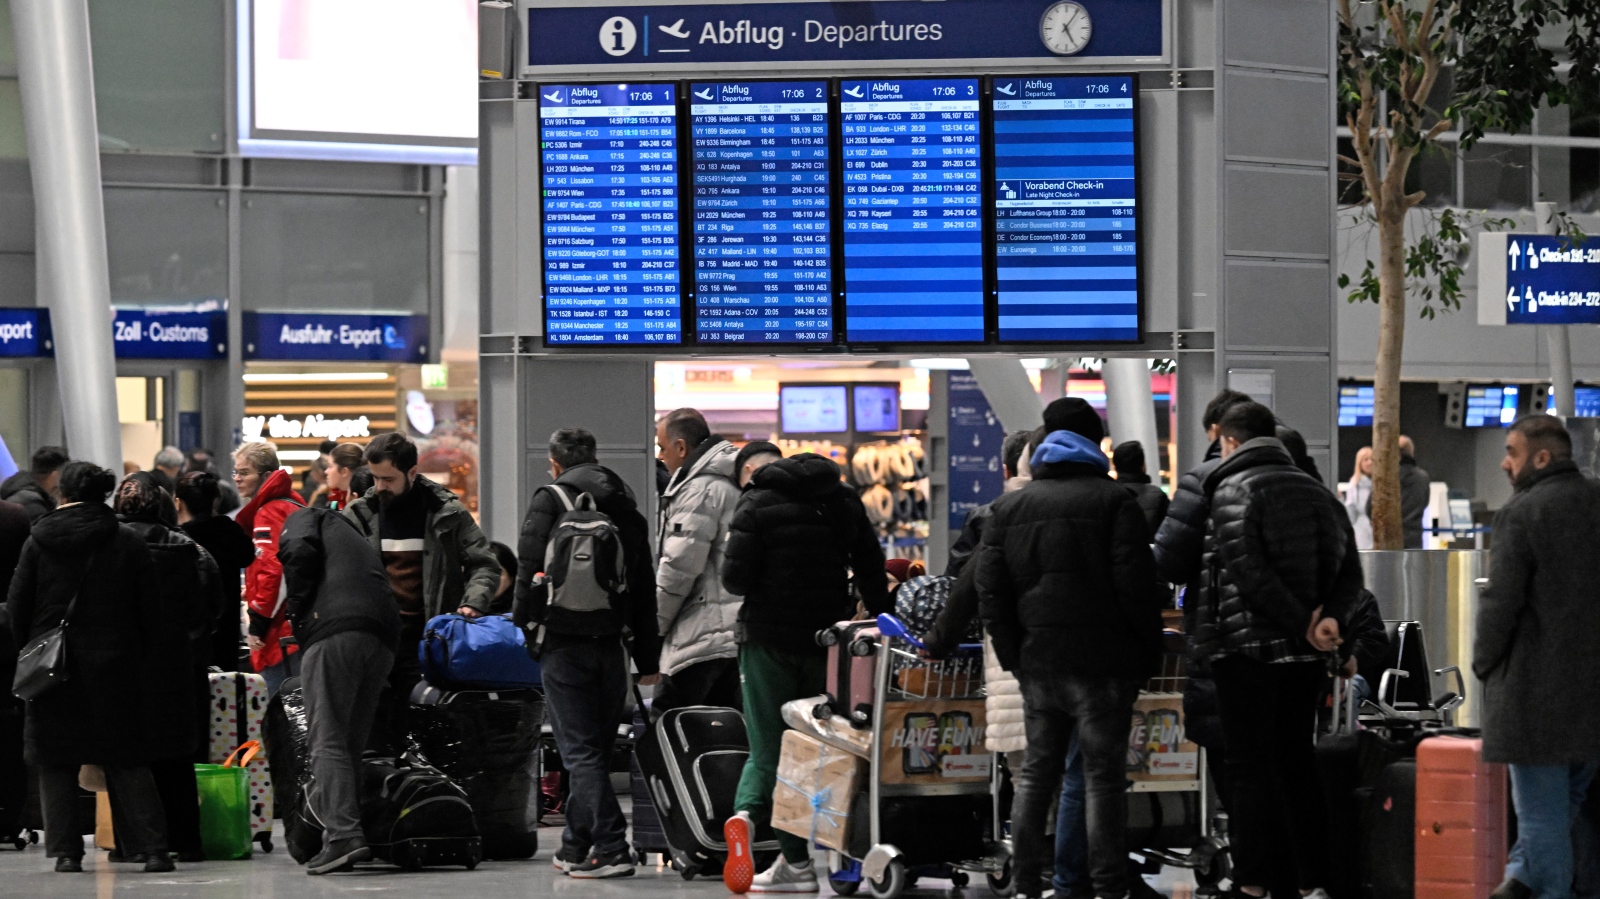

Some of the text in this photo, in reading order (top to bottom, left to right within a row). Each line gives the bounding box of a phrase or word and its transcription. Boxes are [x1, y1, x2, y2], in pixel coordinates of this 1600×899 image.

[699, 20, 942, 49] Abflug Departures
[722, 85, 749, 95] Abflug
[872, 83, 899, 93] Abflug
[968, 86, 974, 95] 3
[1025, 80, 1052, 91] Abflug
[1086, 85, 1109, 93] 17:06
[1121, 84, 1127, 92] 4
[571, 88, 598, 99] Abflug
[630, 92, 652, 100] 17:06
[665, 91, 669, 100] 1
[816, 88, 822, 97] 2
[933, 87, 955, 95] 17:06
[1025, 181, 1103, 189] Vorabend Check-in
[1540, 248, 1570, 262] Check-in
[1538, 291, 1568, 306] Check-in
[115, 322, 208, 342] Zoll Customs
[280, 324, 381, 348] Ausfuhr Export
[268, 414, 302, 437] the
[302, 414, 370, 441] Airport
[891, 727, 984, 748] HAVE FUN!
